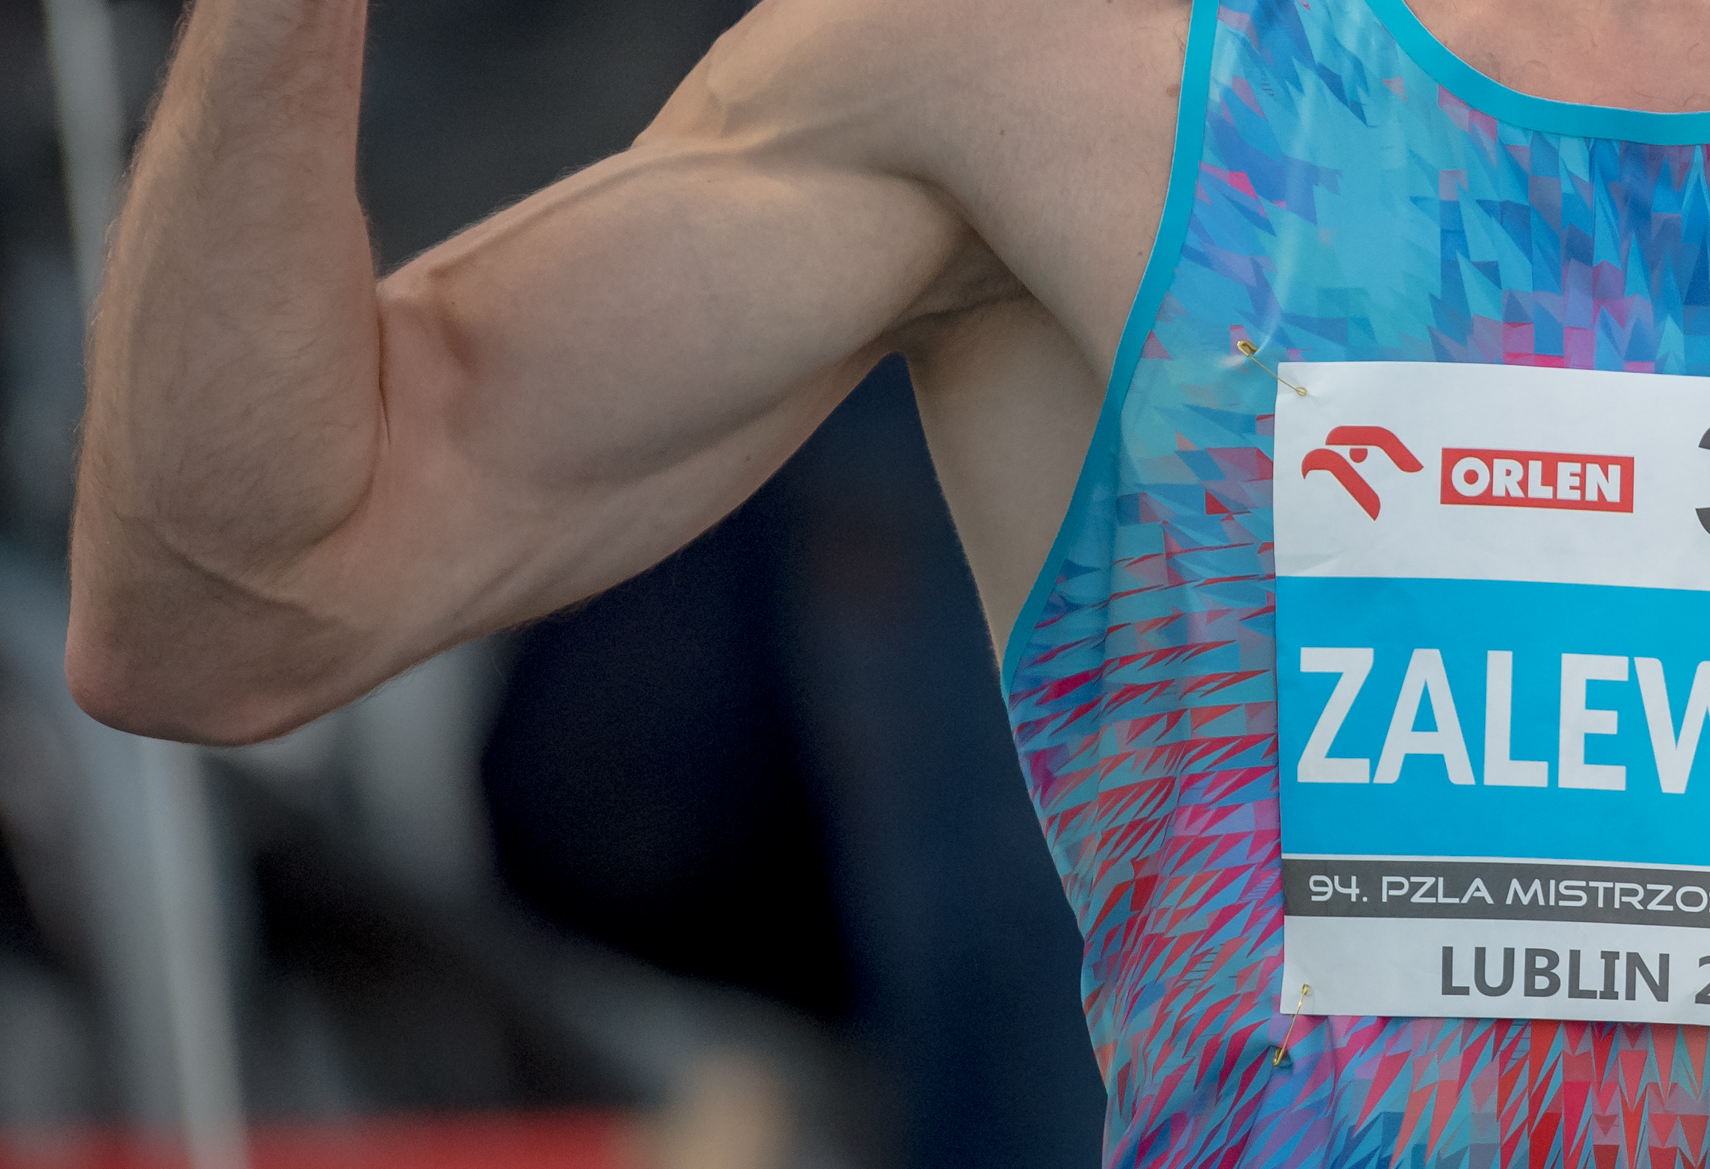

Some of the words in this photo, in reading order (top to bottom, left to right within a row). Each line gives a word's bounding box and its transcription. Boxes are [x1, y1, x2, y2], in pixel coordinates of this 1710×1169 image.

[1451, 457, 1622, 503] ORLEN
[1309, 874, 1368, 903] 94.
[1381, 876, 1493, 904] PZLA
[1441, 945, 1670, 1002] LUBLIN
